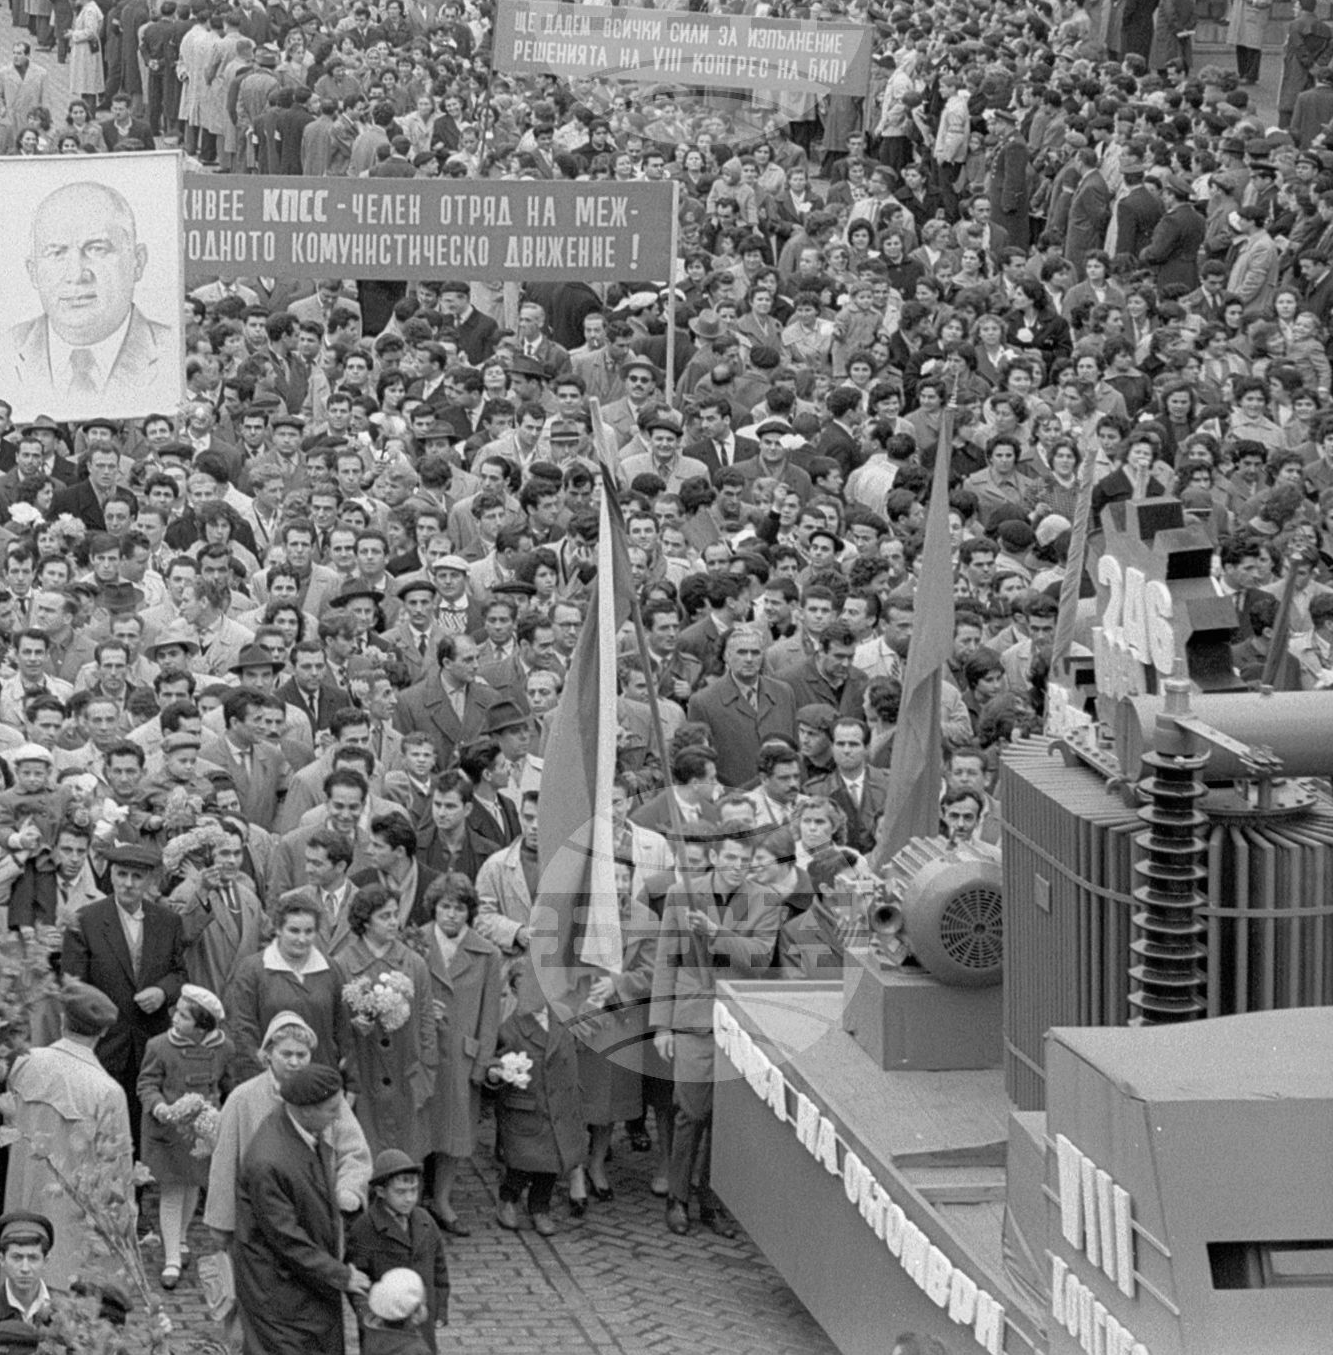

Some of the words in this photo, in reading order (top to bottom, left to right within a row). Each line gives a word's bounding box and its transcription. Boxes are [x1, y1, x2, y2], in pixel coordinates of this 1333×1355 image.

[514, 11, 537, 35] ЩЕ
[543, 14, 591, 37] ДАДЕМ
[603, 17, 661, 41] ВСИЧКИ
[669, 22, 709, 45] СИЛИ
[718, 26, 738, 47] ЗА
[747, 27, 844, 54] ИЗПЪЛНЕНИЕ
[513, 39, 608, 67] РЕШЕНИЯТА
[619, 47, 640, 68] НА
[652, 47, 682, 72] VIII
[692, 53, 769, 78] КОНГРЕС
[777, 58, 799, 80] НА
[807, 57, 847, 85] БКП!
[263, 188, 328, 222] КПСС
[352, 193, 421, 225] ЧЕЛЕН
[440, 194, 513, 226] ОТРЯД
[527, 195, 556, 227] НА
[575, 196, 638, 227] МЕЖ-
[183, 230, 275, 261] ОДНОТО
[291, 232, 489, 266] КОМУНИСТИЧЕСКО
[503, 235, 616, 268] ДВИЖЕНИЕ
[796, 1091, 839, 1176] НА
[844, 1151, 1005, 1355] ОКТОМВРИ
